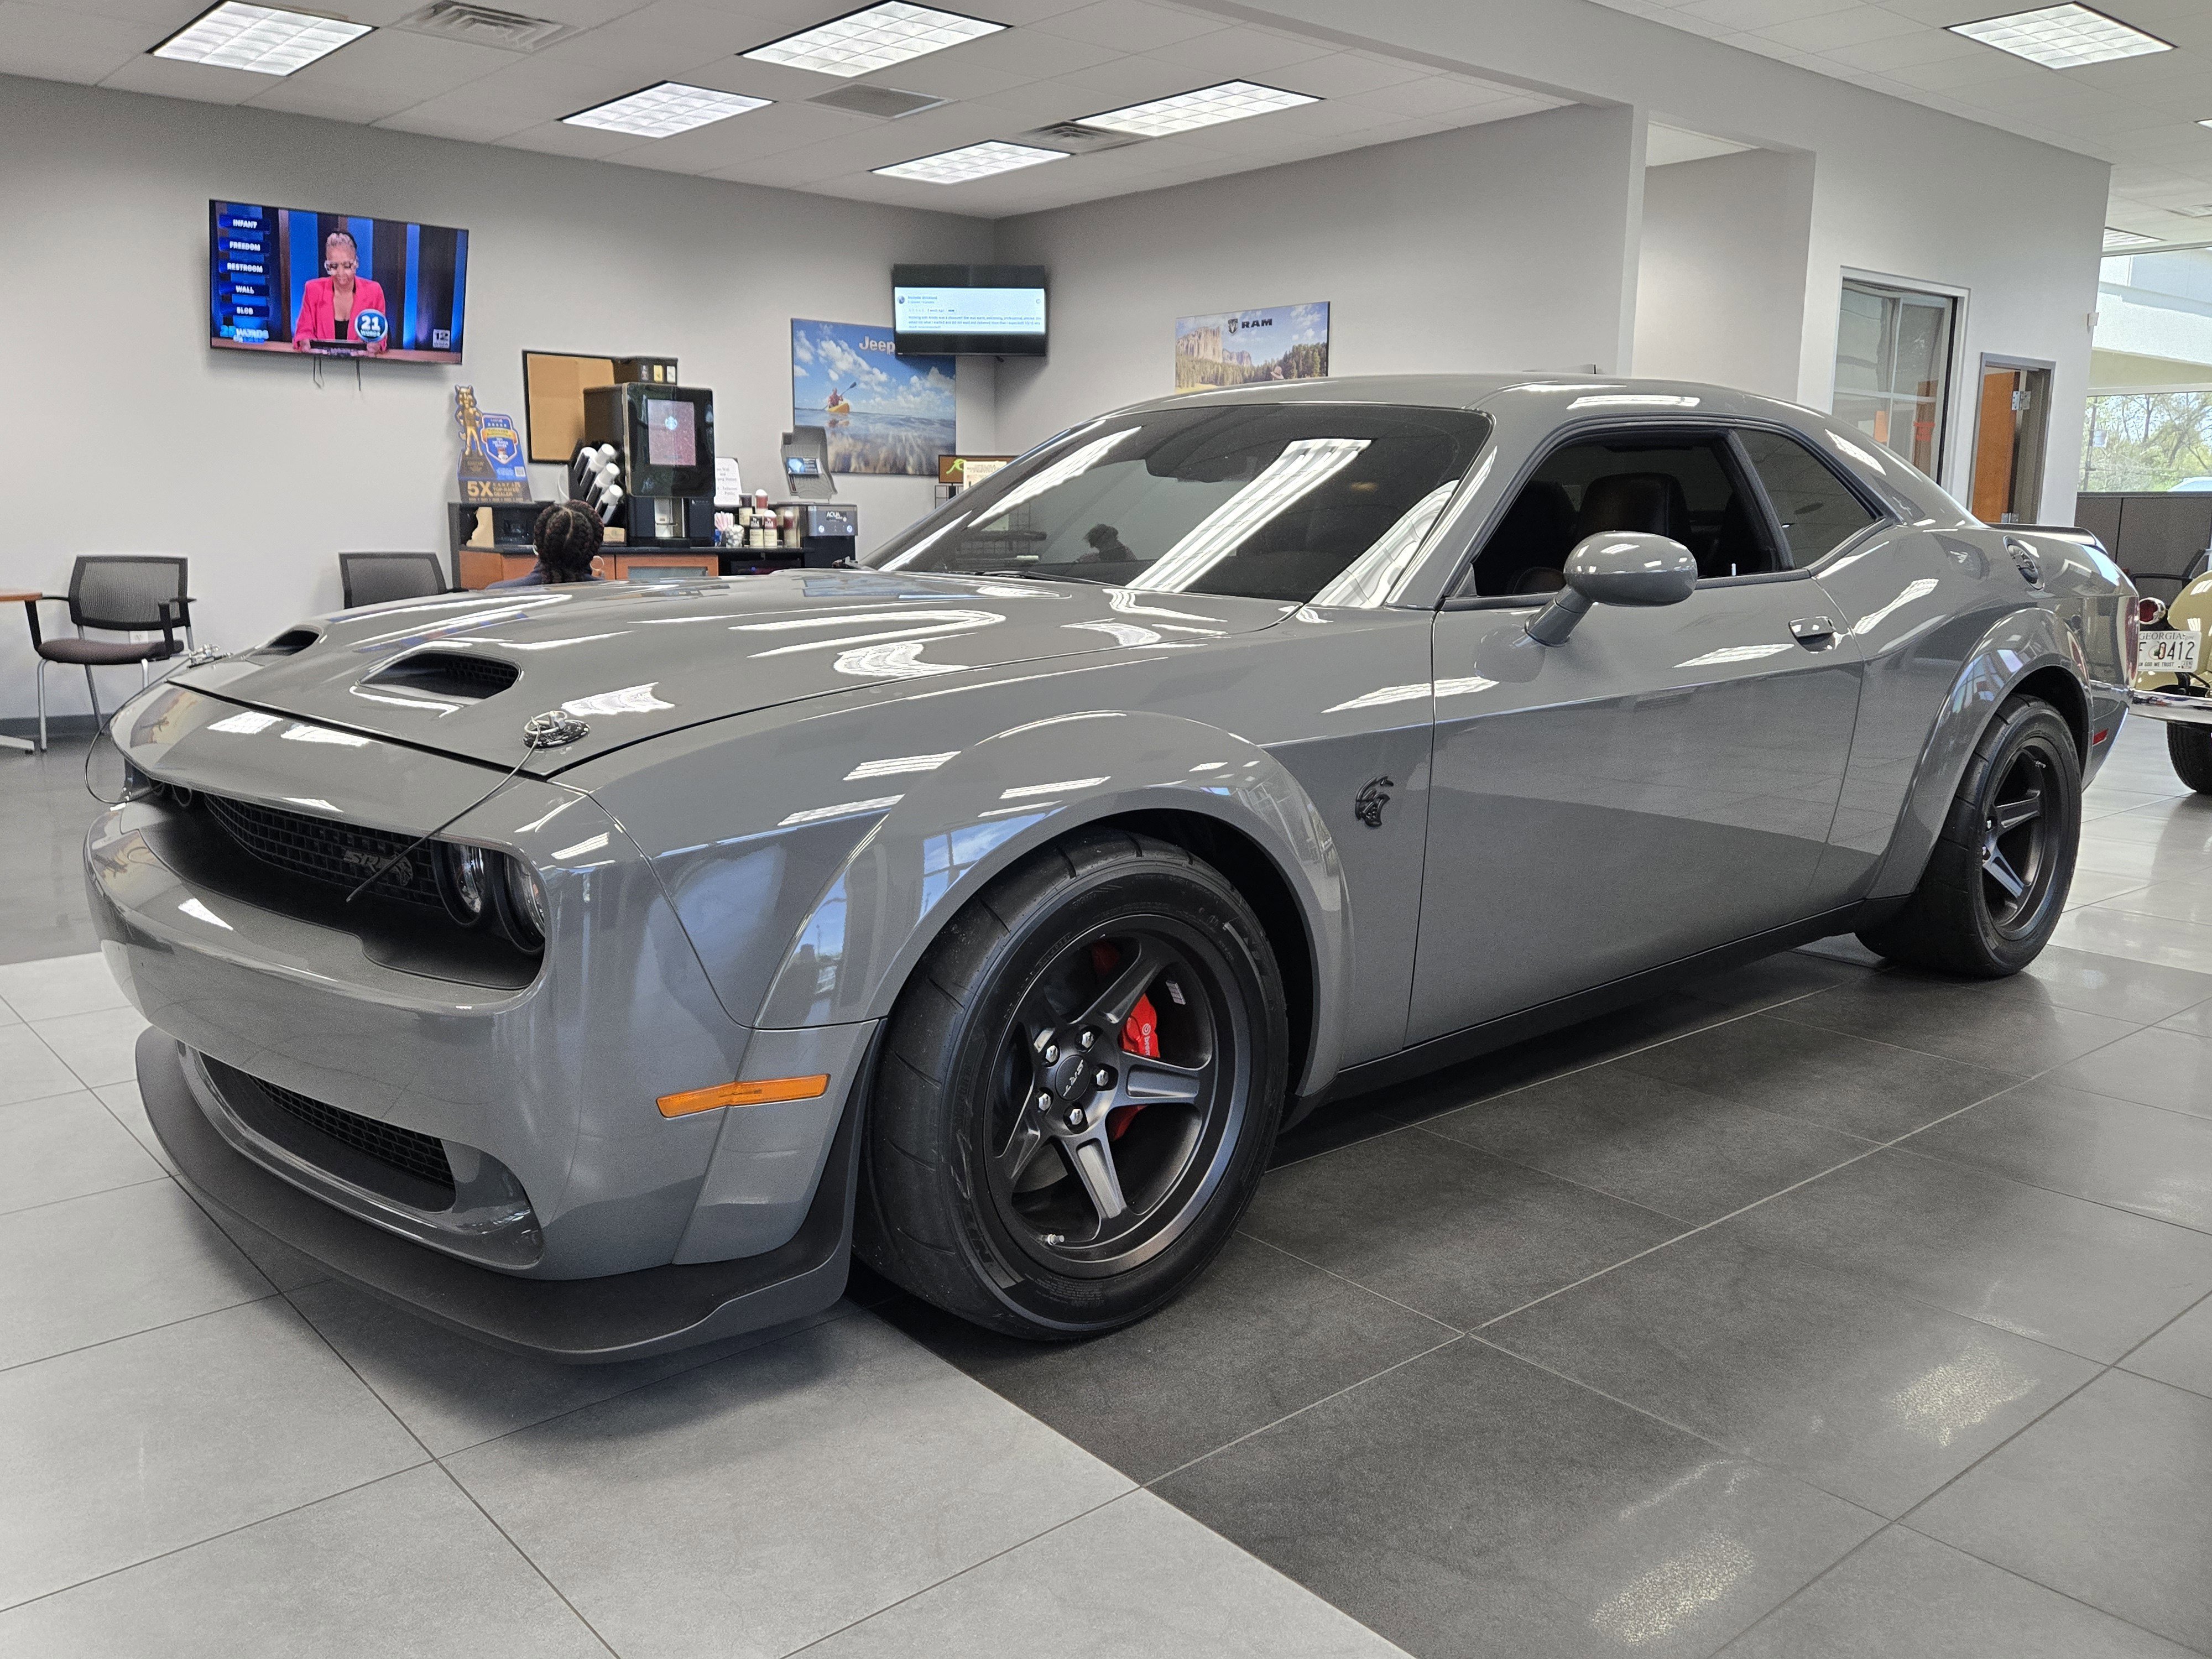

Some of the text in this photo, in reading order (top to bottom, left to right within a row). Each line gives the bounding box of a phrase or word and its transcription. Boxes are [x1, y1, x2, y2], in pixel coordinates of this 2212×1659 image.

[233, 219, 258, 228] INFANT
[229, 241, 260, 251] FREEDOM
[227, 263, 263, 273] RESTROOM
[236, 285, 254, 294] WALL
[237, 306, 254, 315] BLOB
[361, 315, 381, 331] 21
[1241, 319, 1272, 329] RAM
[859, 333, 896, 355] Jeep
[467, 481, 494, 497] 5X
[2139, 632, 2182, 640] GEORGIA
[2158, 641, 2195, 660] 0412
